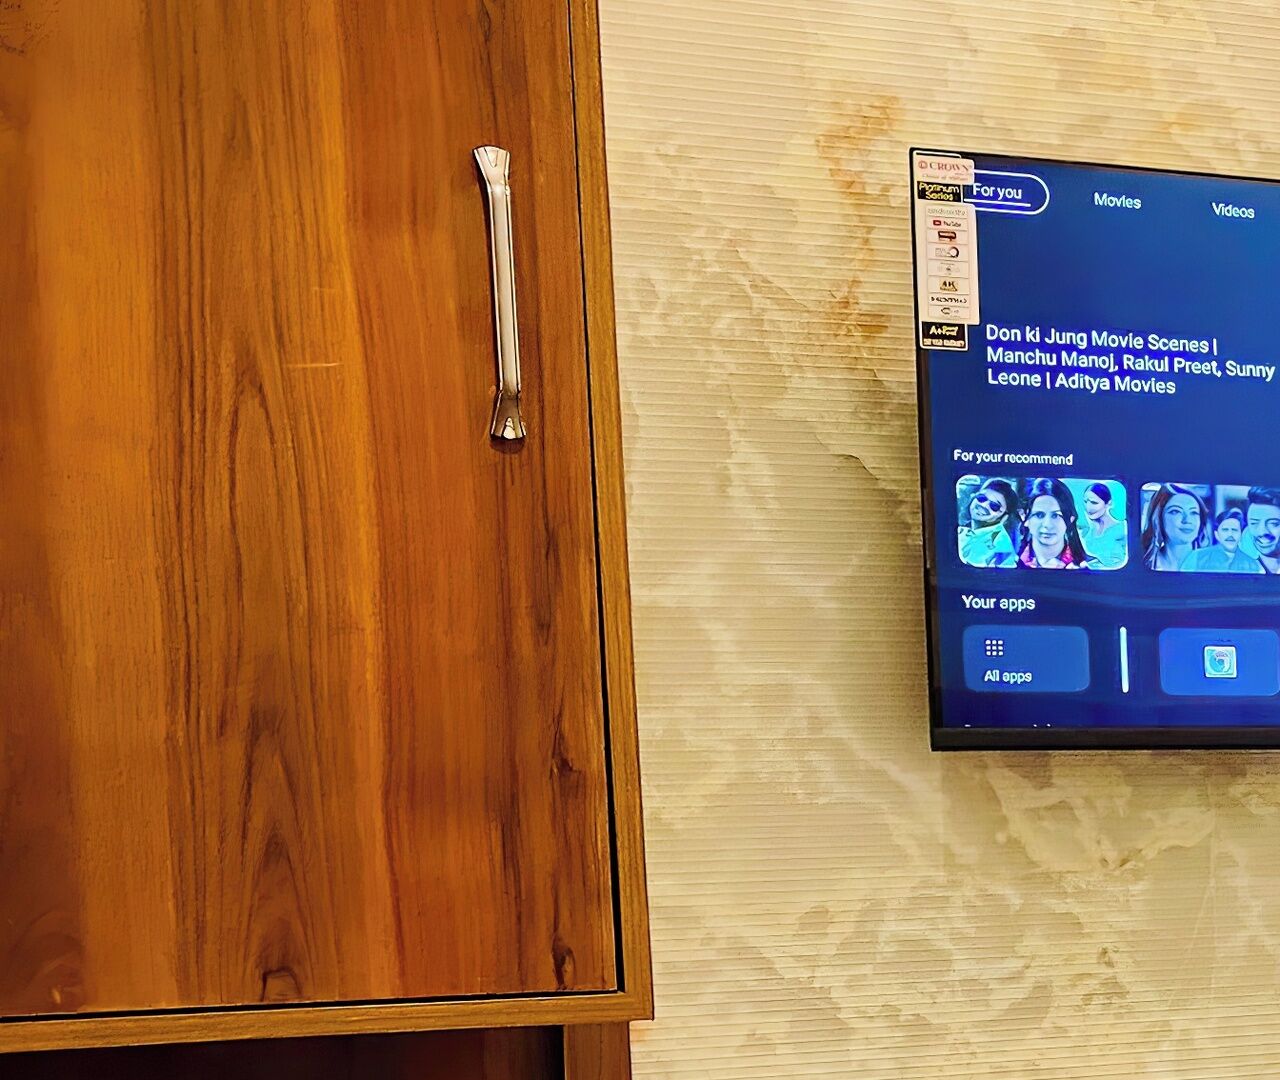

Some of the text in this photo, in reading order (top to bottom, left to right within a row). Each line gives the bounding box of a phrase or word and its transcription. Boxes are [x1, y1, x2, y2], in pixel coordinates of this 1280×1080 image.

[972, 182, 1022, 201] For you
[1094, 191, 1142, 210] Movies
[1211, 202, 1255, 219] Videos
[986, 324, 1021, 341] Don
[1025, 325, 1040, 342] ki
[1044, 328, 1087, 349] Jung
[1091, 330, 1144, 349] Movie
[1147, 333, 1210, 353] Scenes
[987, 346, 1276, 382] Manchu Manoj, Rakul Preet, Sunny
[987, 368, 1042, 387] Leone
[1054, 372, 1110, 393] Aditya
[1114, 375, 1176, 394] Movies
[953, 449, 1074, 466] For your recommend
[961, 594, 1036, 612] Your apps
[984, 669, 1033, 685] All apps
